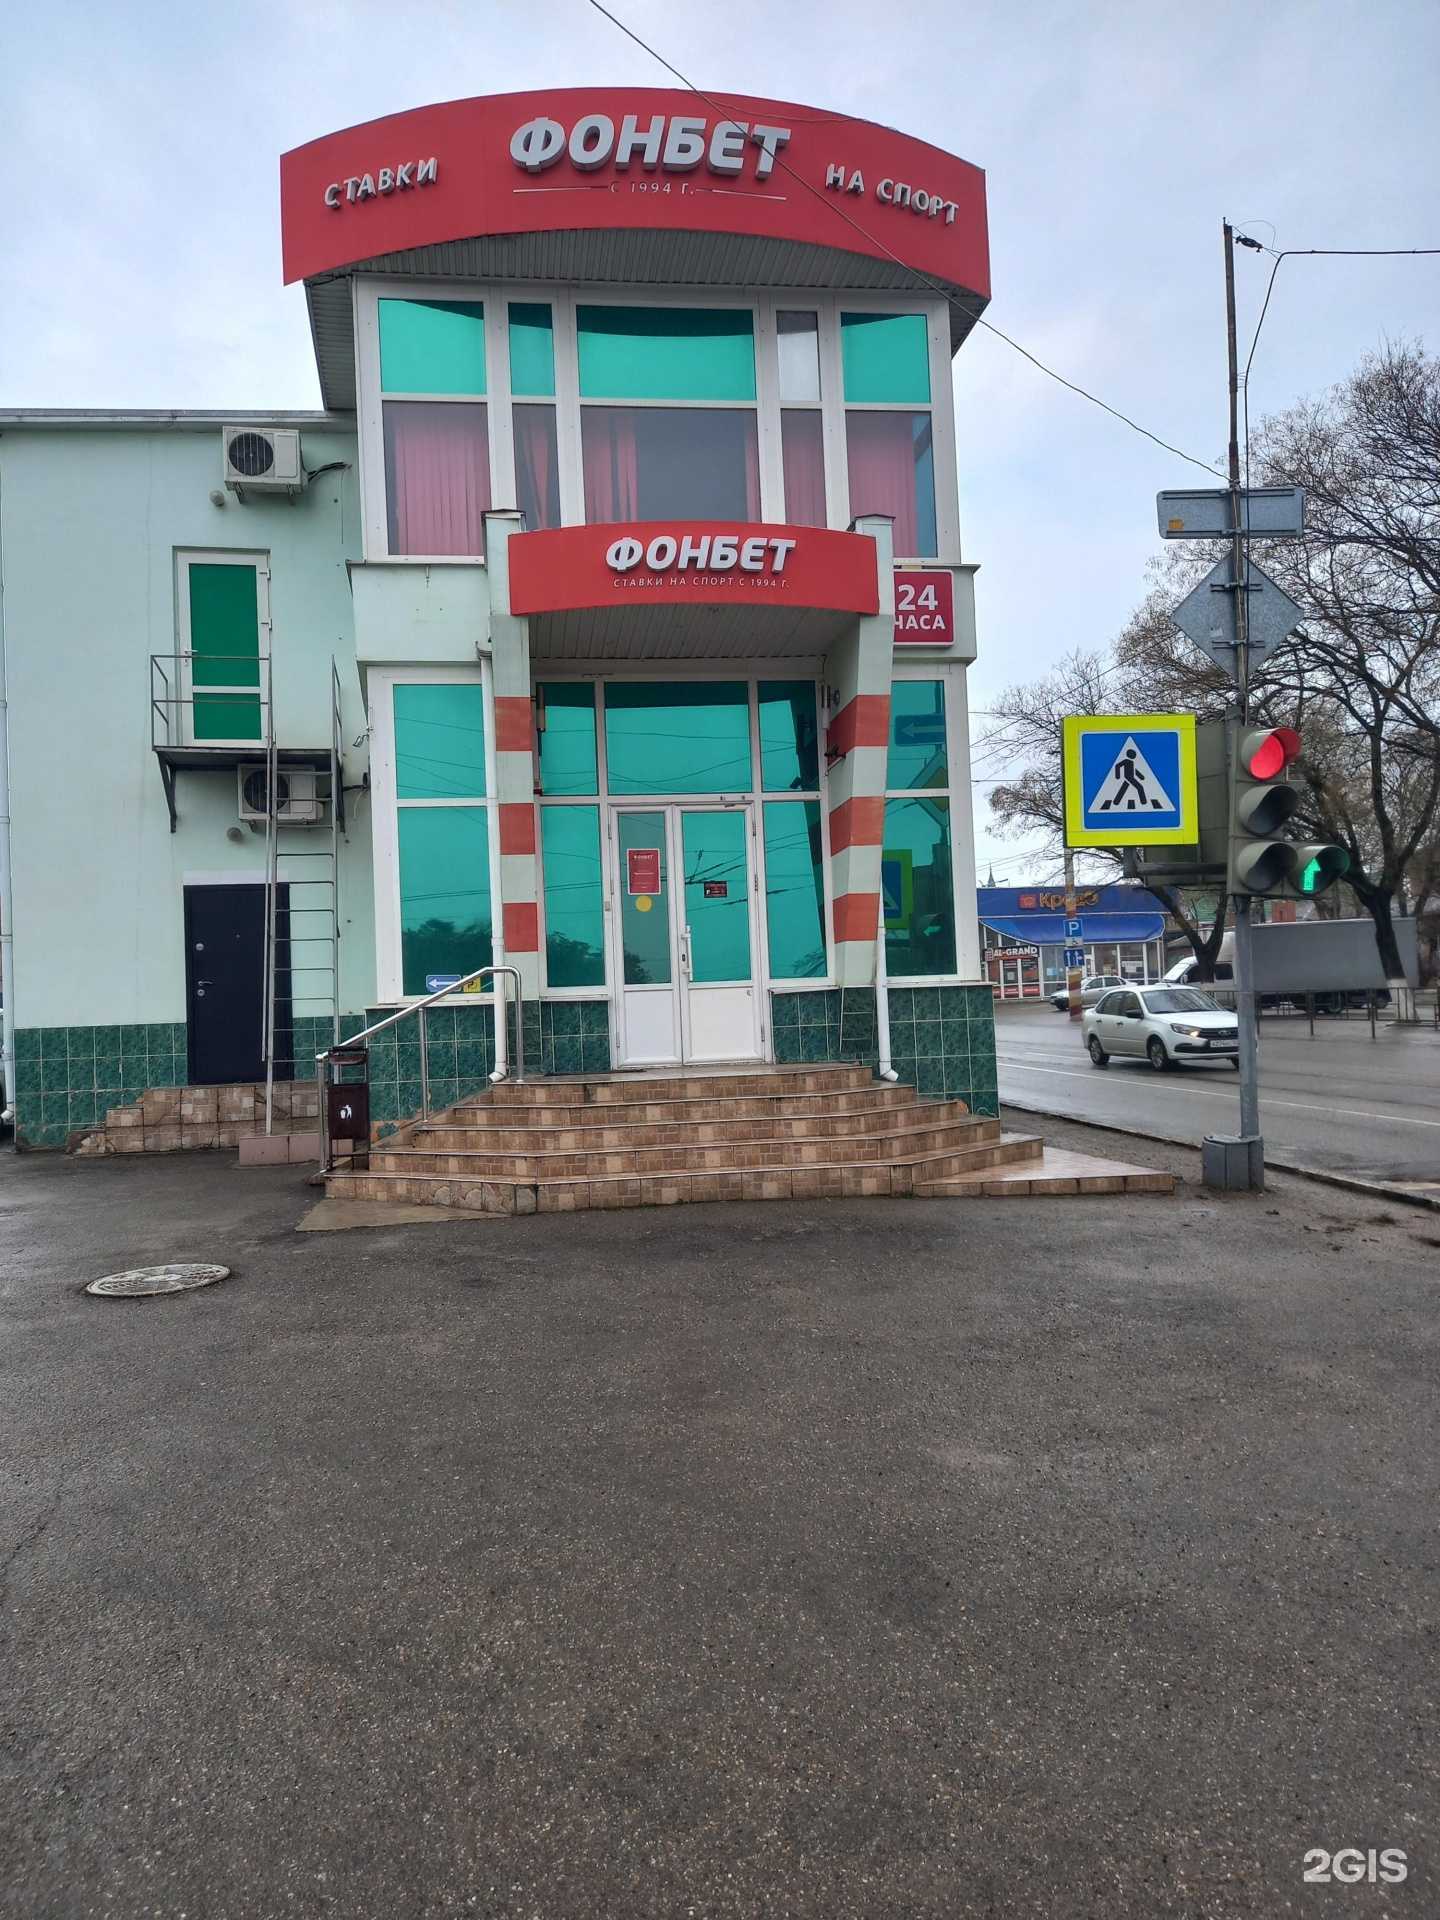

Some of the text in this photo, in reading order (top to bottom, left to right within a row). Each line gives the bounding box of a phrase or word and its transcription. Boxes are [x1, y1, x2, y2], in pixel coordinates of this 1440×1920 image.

[510, 114, 792, 180] ФОНБЕТ
[324, 157, 438, 208] СТАВКИ
[631, 183, 672, 194] 1994
[825, 163, 960, 225] НА СПОРТ
[605, 535, 797, 574] ФОНБЕТ
[613, 577, 664, 588] СТАВКИ
[670, 577, 687, 586] НА
[693, 577, 733, 586] СПОРТ
[739, 578, 745, 586] С
[751, 578, 776, 587] 1994
[898, 584, 938, 611] 24
